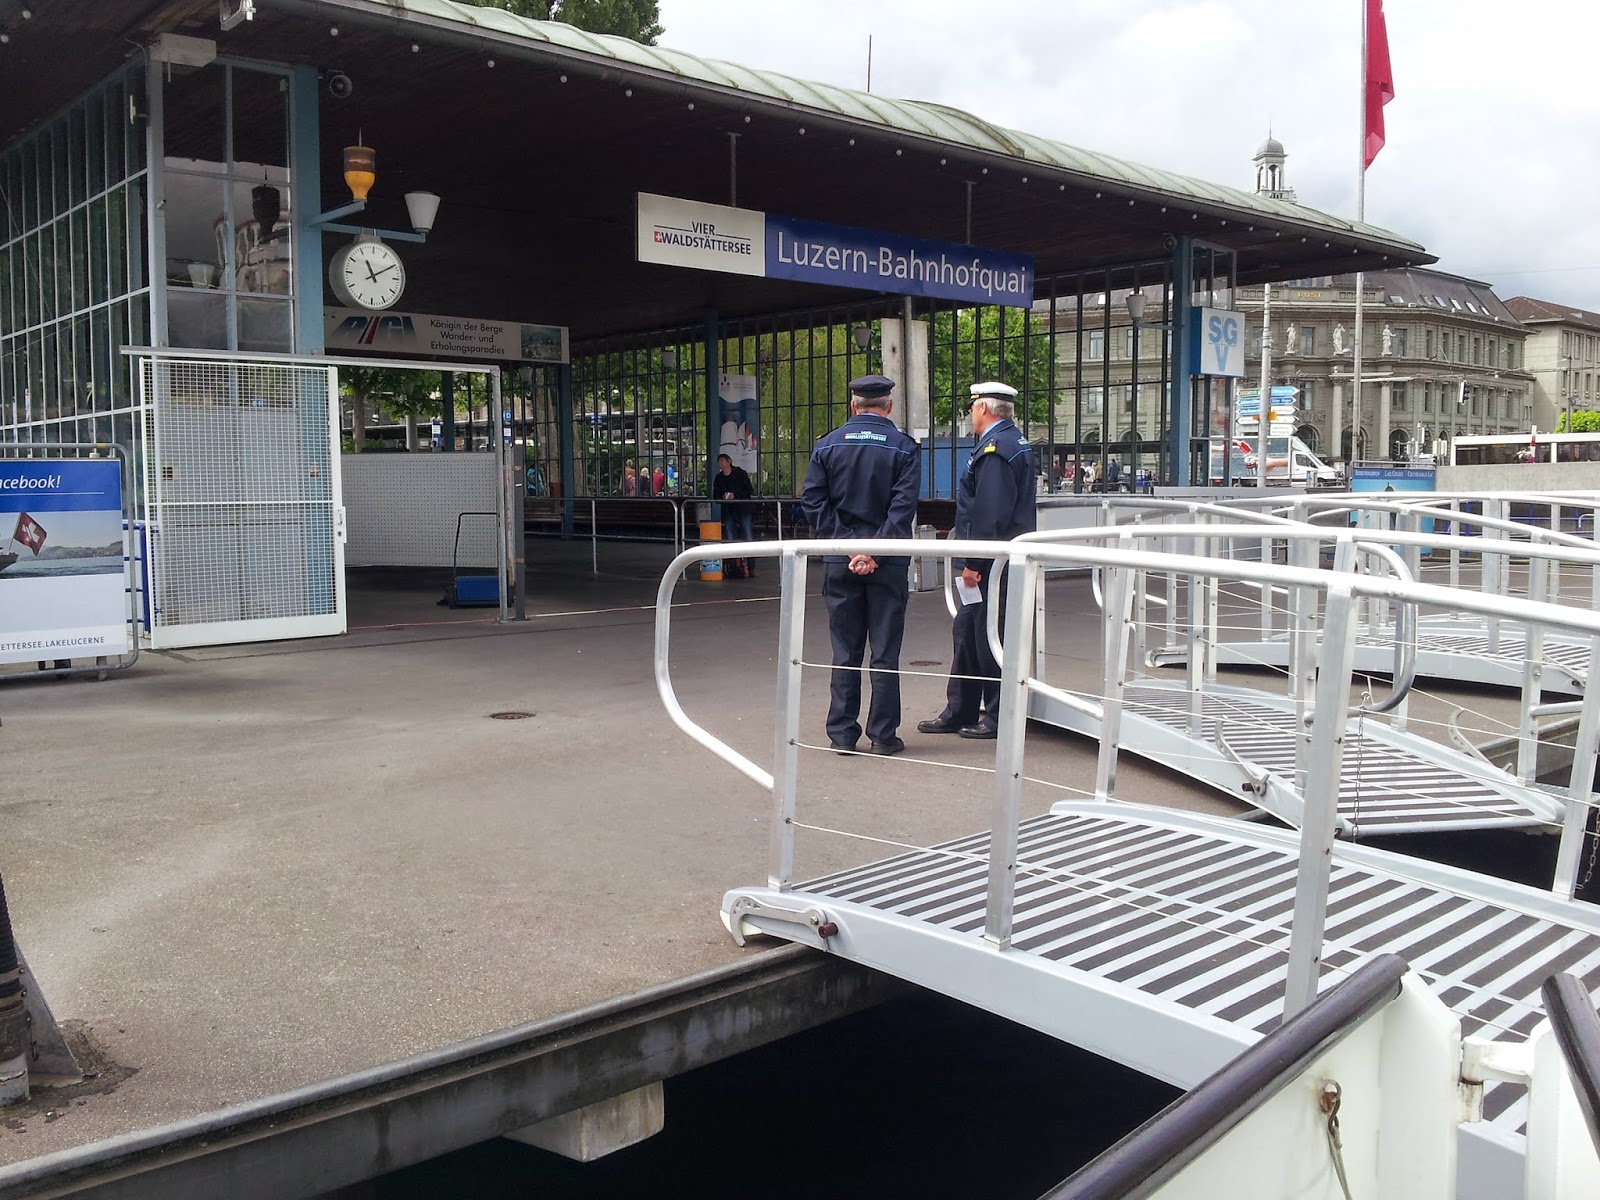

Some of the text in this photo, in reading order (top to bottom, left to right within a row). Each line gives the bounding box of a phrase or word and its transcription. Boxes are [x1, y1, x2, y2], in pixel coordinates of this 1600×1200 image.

[691, 221, 715, 236] VIER
[661, 232, 751, 255] WALDSTÄTTERSEE
[778, 231, 1026, 297] Luzern-Bahnhofquai
[430, 319, 504, 335] Königin der Berge
[478, 333, 494, 343] und
[430, 342, 505, 355] Erholungsparadies
